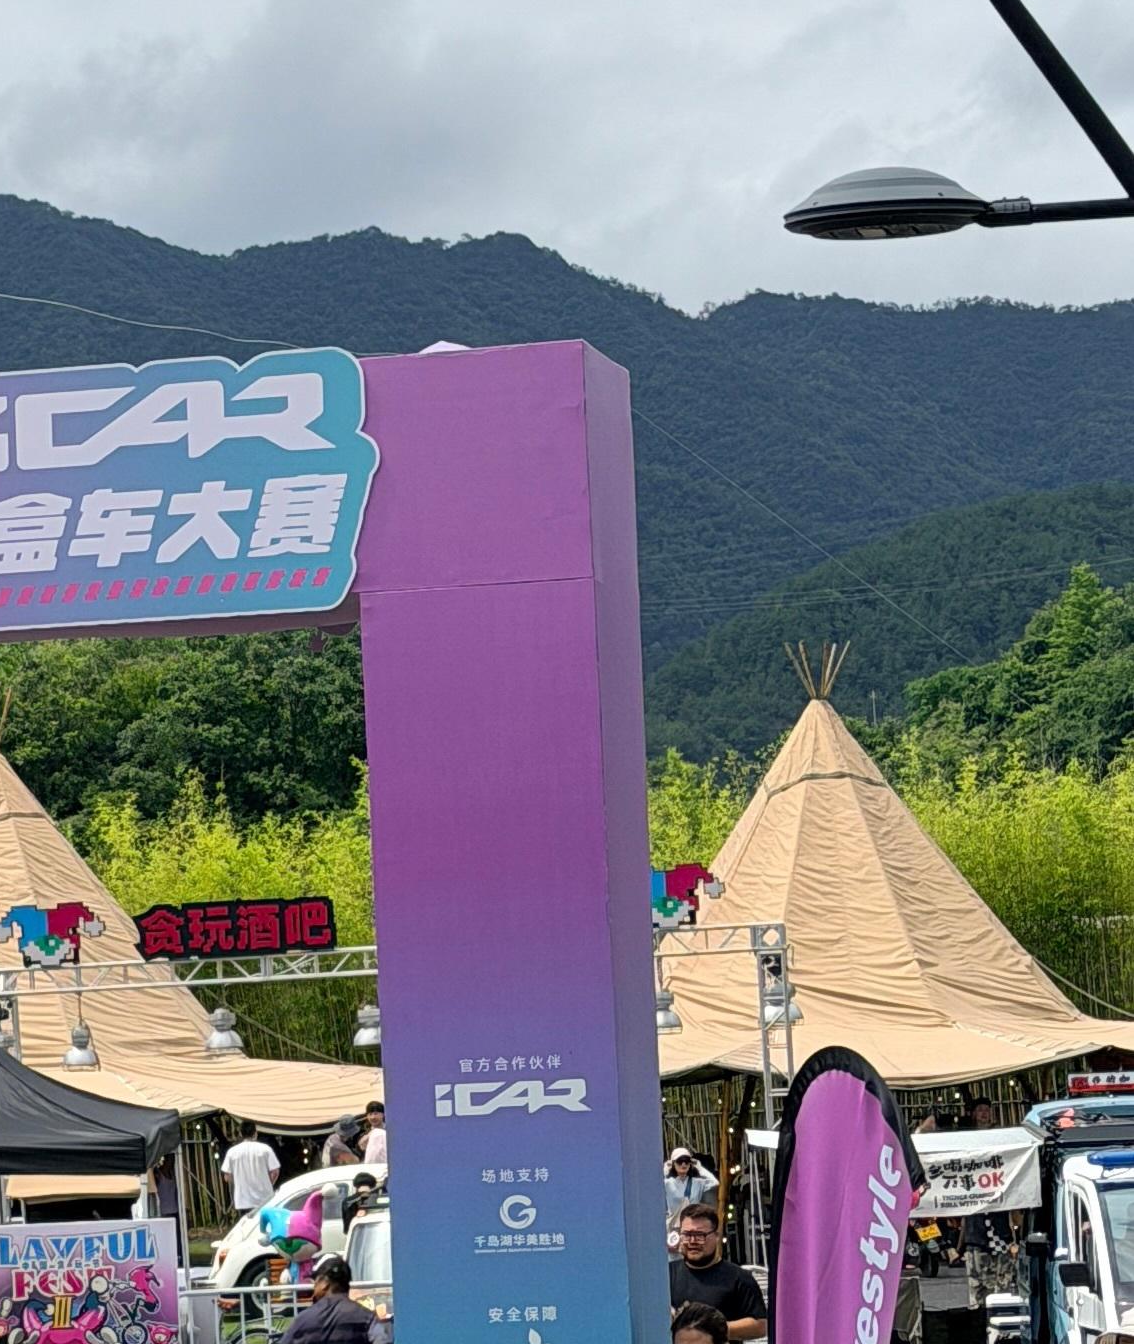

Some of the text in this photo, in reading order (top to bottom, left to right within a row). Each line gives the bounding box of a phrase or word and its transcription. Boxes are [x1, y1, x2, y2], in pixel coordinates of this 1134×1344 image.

[141, 901, 332, 954] 贪玩酒吧
[459, 1054, 563, 1073] 官方合作伙伴
[481, 1168, 550, 1183] 场地支持
[474, 1233, 565, 1248] 千岛湖华美胜地
[12, 1266, 115, 1301] FEST
[488, 1306, 558, 1323] 安全保障
